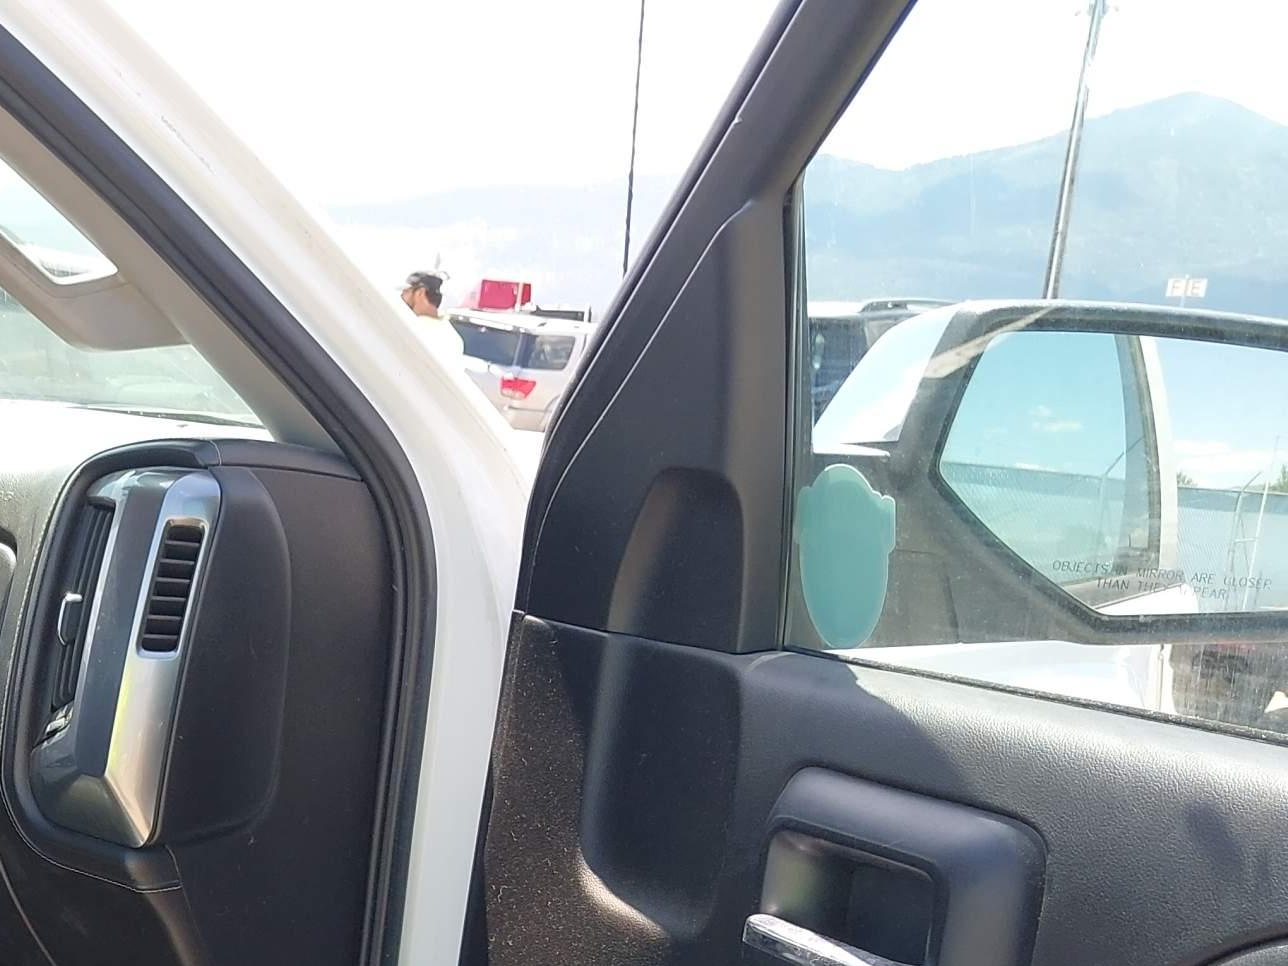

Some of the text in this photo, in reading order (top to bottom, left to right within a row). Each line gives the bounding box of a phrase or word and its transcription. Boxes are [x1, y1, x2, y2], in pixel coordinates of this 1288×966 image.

[1096, 577, 1130, 591] THAN
[1136, 567, 1185, 583] MIRROR
[1191, 571, 1216, 586] ARE
